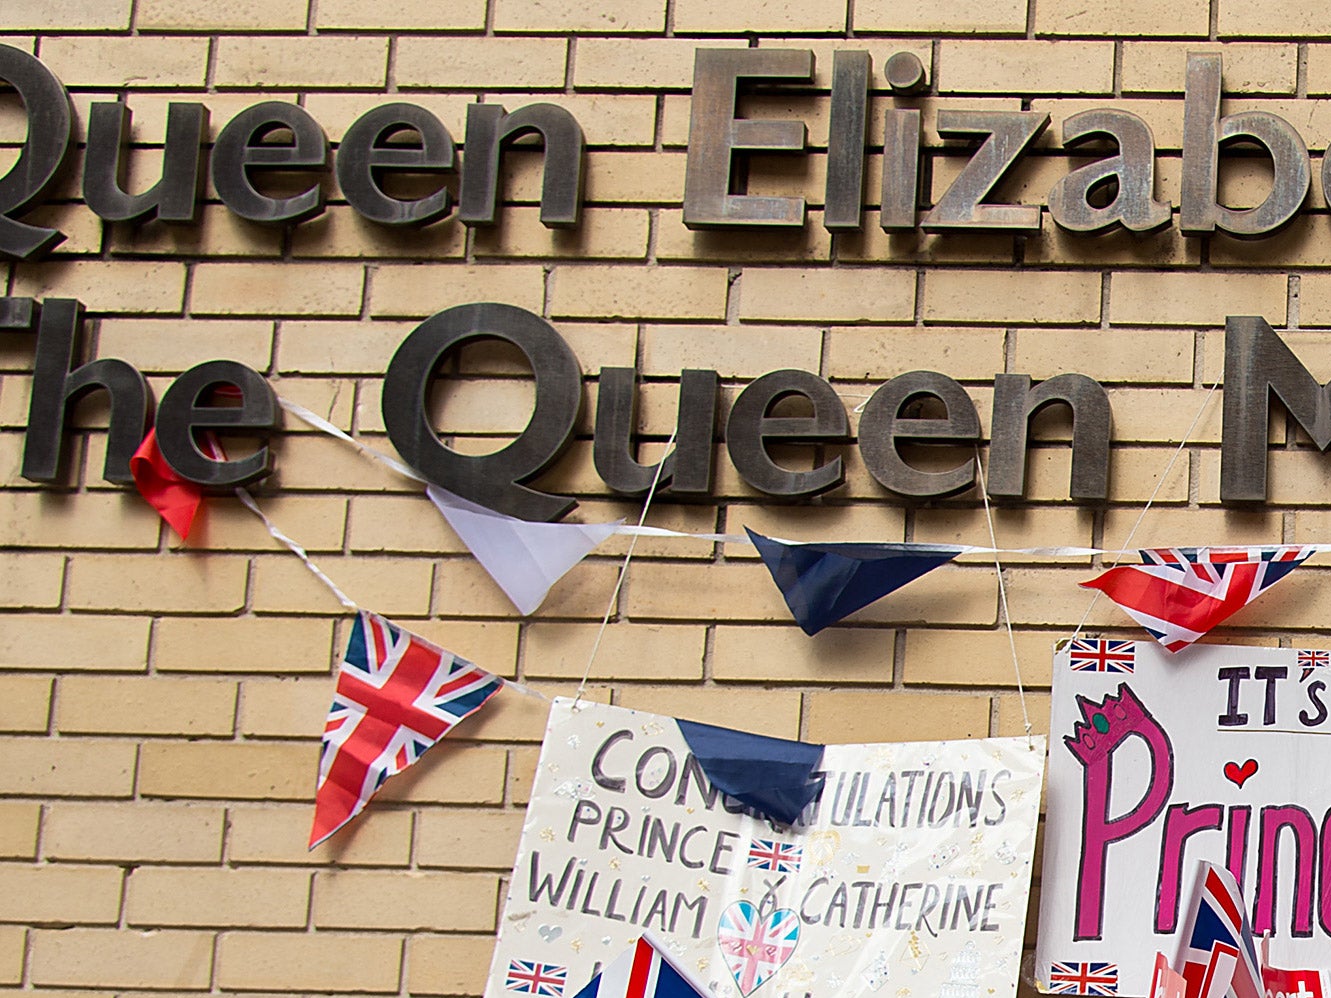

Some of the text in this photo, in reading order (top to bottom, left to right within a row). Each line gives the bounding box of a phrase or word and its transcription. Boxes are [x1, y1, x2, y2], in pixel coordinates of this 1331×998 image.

[0, 297, 276, 487] he
[382, 302, 1113, 522] Queen
[590, 730, 1012, 834] CONTULATIONS
[567, 799, 741, 876] PRINCE
[529, 850, 710, 940] WILLIAM
[800, 876, 1004, 938] CATHERINE
